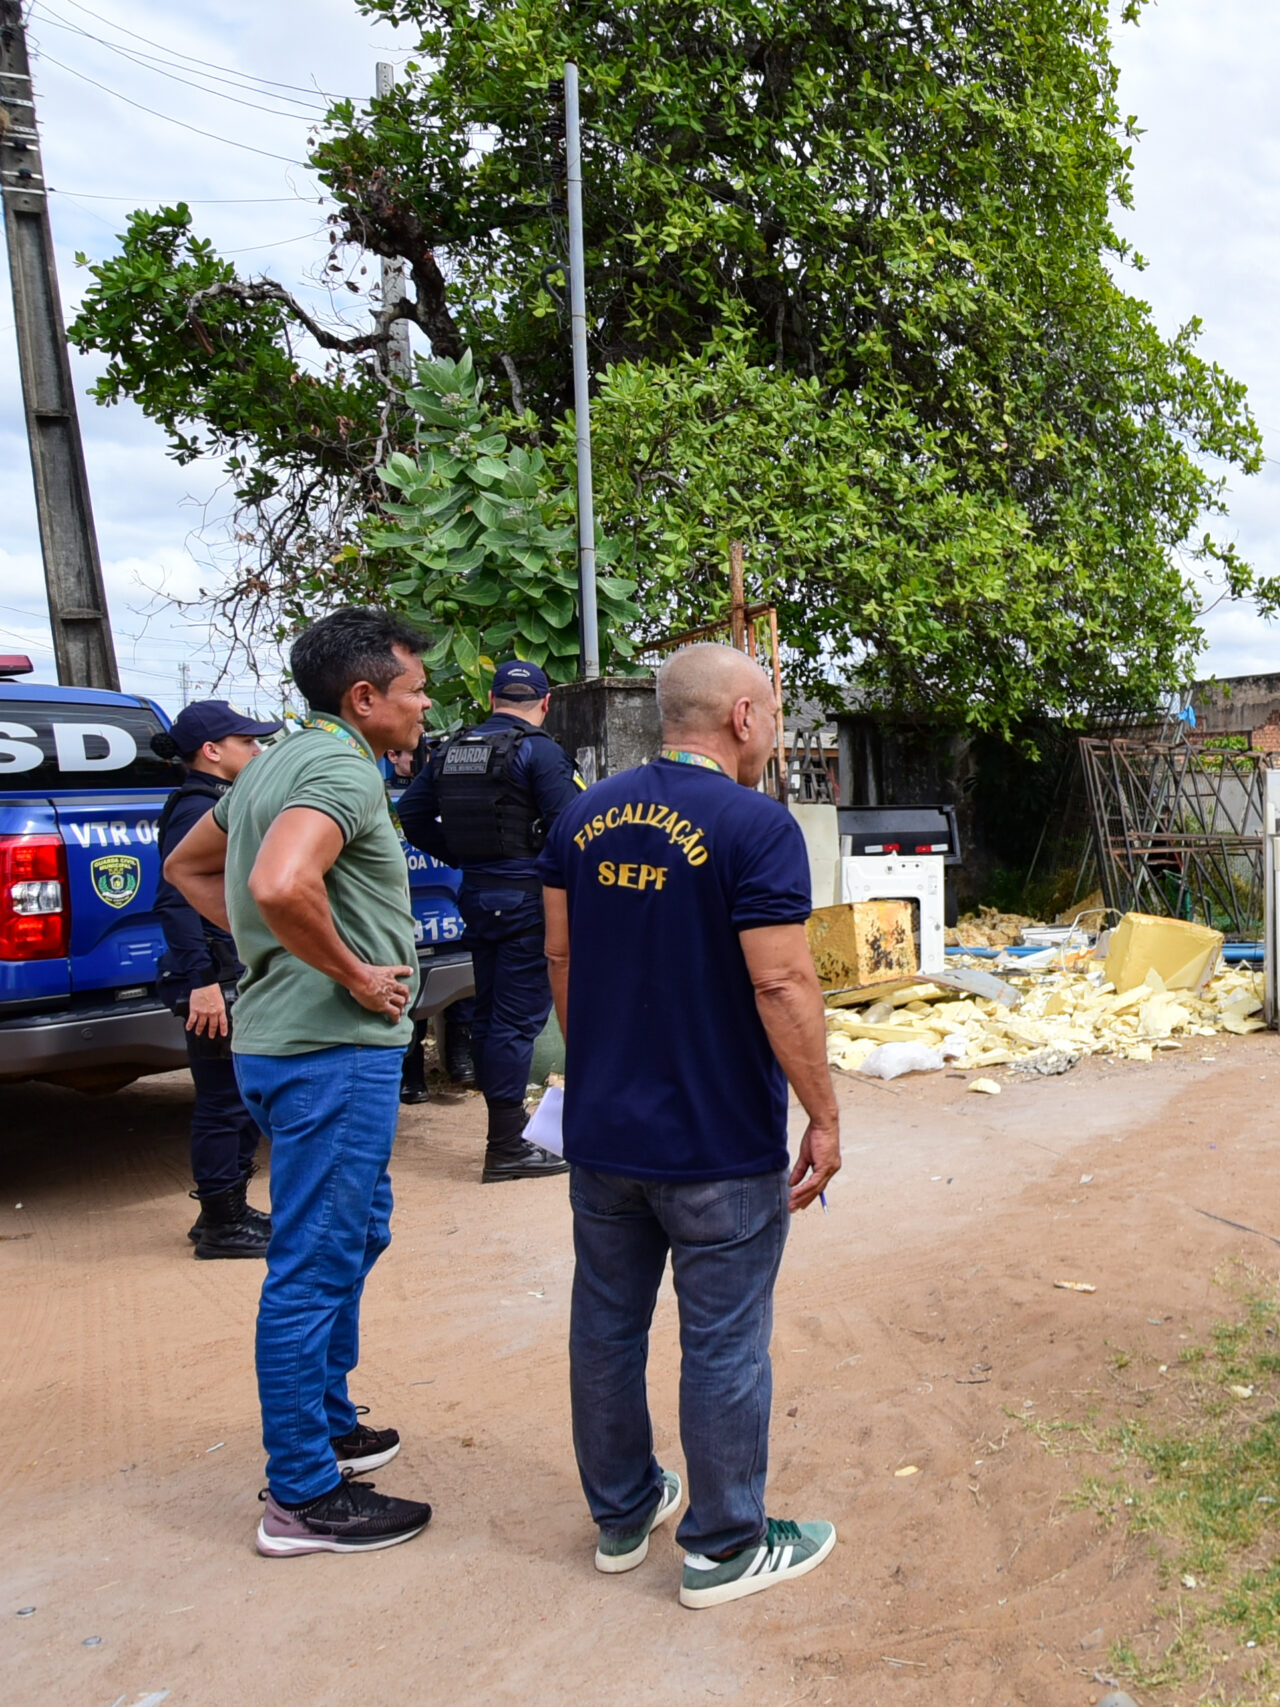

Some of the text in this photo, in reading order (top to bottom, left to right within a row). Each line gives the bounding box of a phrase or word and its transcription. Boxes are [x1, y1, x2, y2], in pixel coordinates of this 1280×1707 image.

[447, 747, 488, 764] GUARDA
[70, 820, 132, 849] VTR
[573, 802, 708, 867] FISCALIZAÇÃO
[407, 854, 428, 871] OA
[597, 860, 669, 890] SEPF
